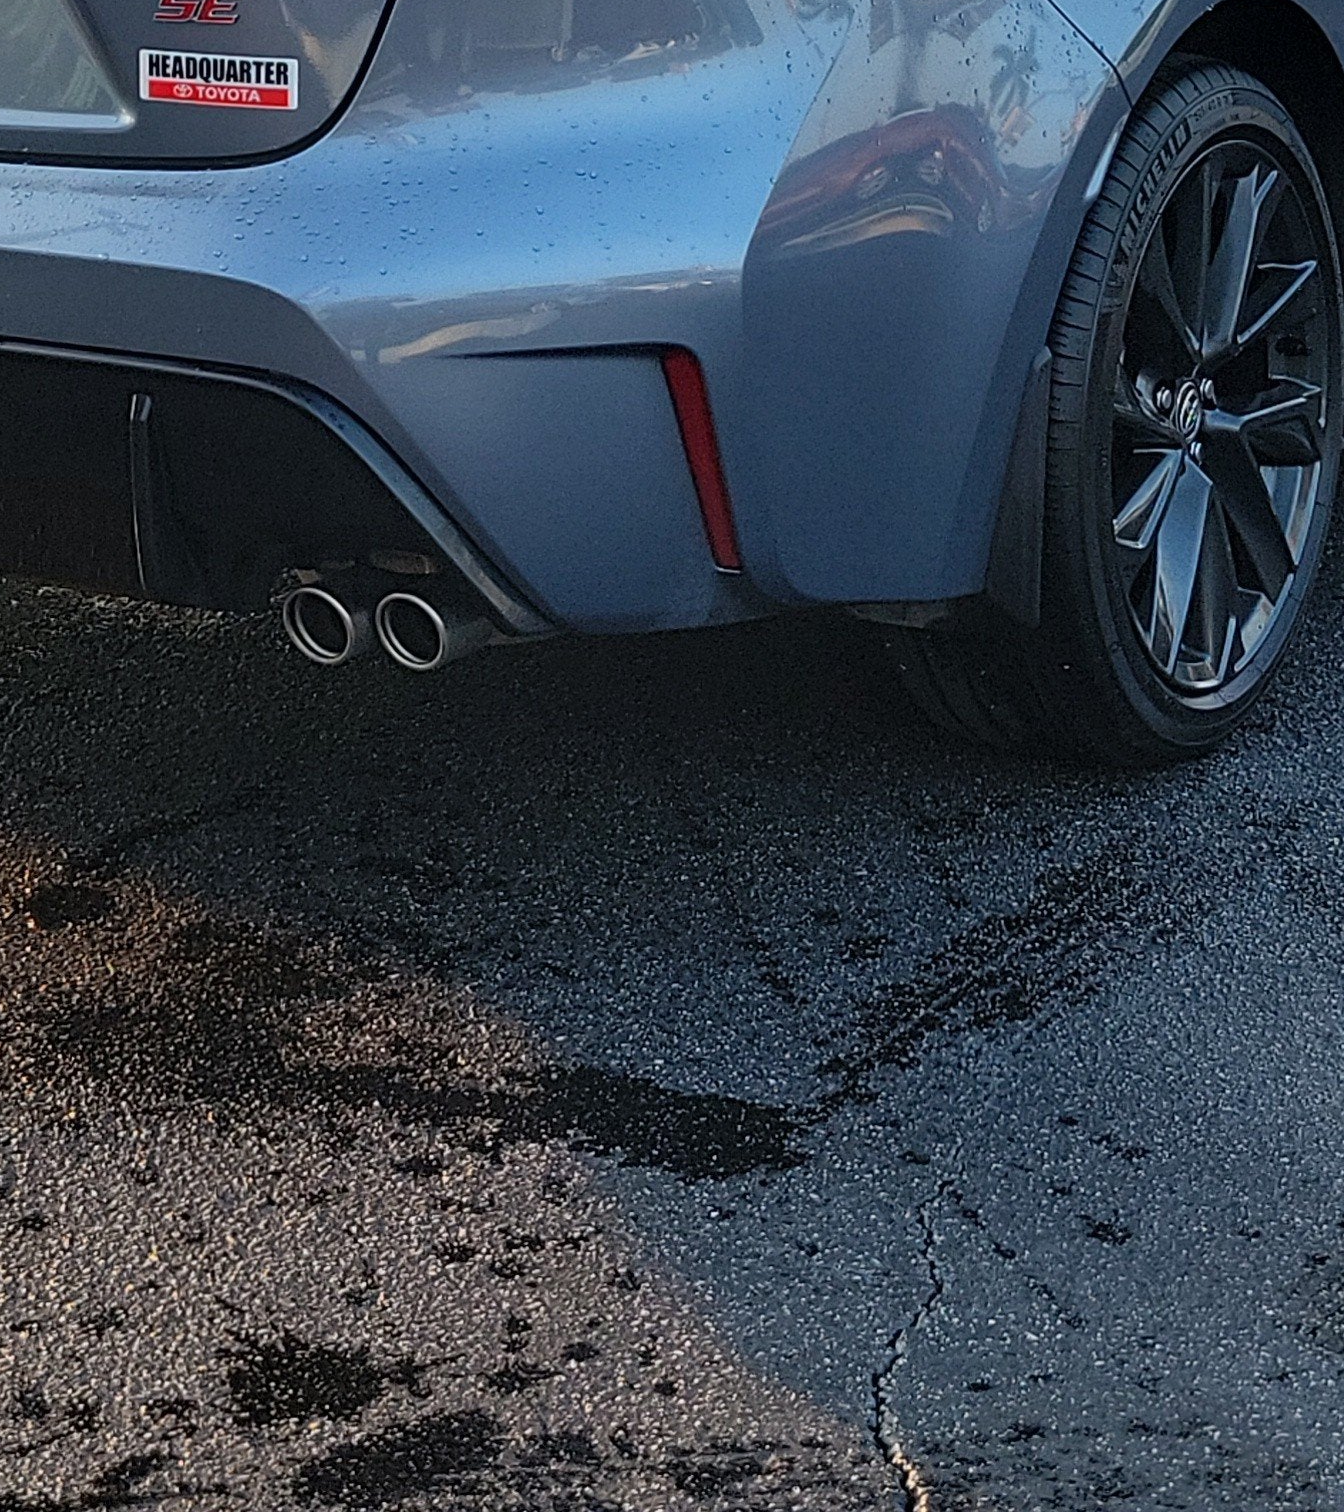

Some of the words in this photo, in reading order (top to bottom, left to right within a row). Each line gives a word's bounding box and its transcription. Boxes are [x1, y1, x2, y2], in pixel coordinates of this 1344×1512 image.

[148, 54, 289, 86] HEADQUARTER
[195, 86, 261, 103] TOYOTA
[1119, 118, 1192, 257] MICHELIN
